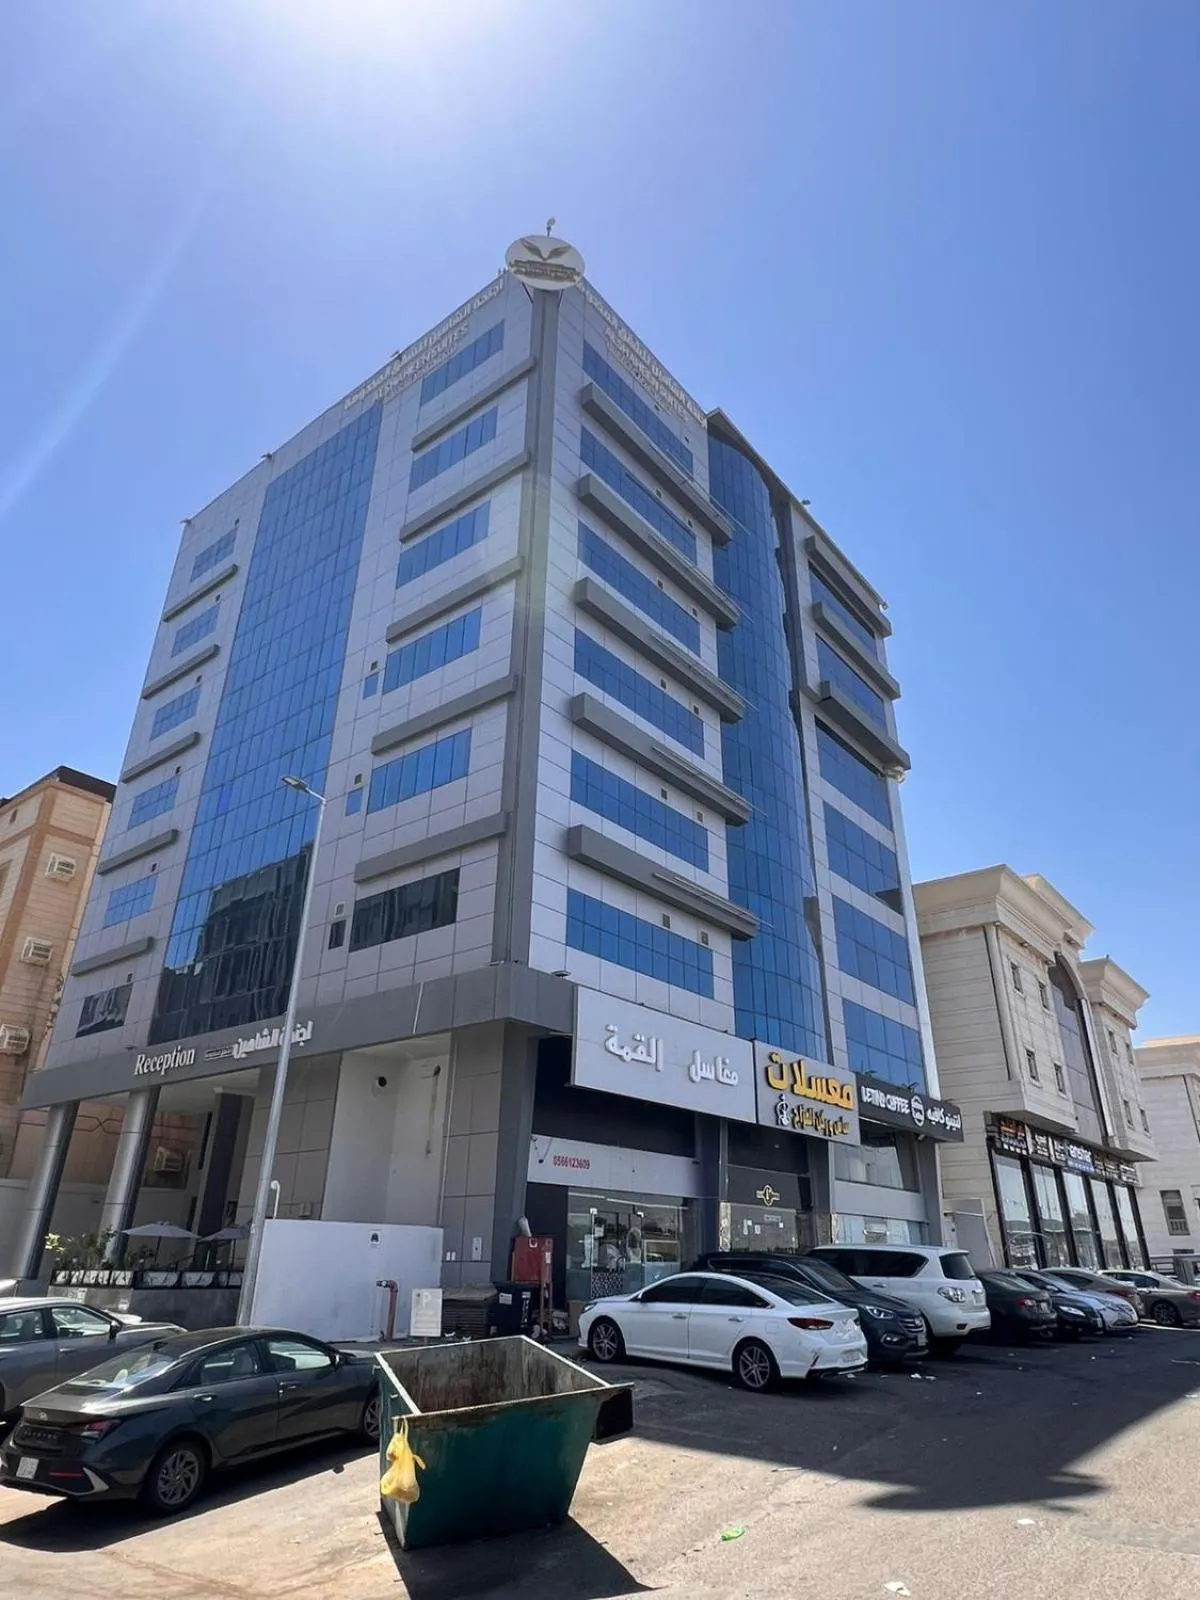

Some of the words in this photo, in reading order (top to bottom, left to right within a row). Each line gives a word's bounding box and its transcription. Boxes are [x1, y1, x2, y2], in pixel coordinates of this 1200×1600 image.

[134, 1045, 195, 1075] Reception
[604, 1024, 663, 1072] القمة
[688, 1049, 738, 1086] مغاسل
[766, 1052, 854, 1110] معسلات
[886, 1094, 910, 1114] COFFEE
